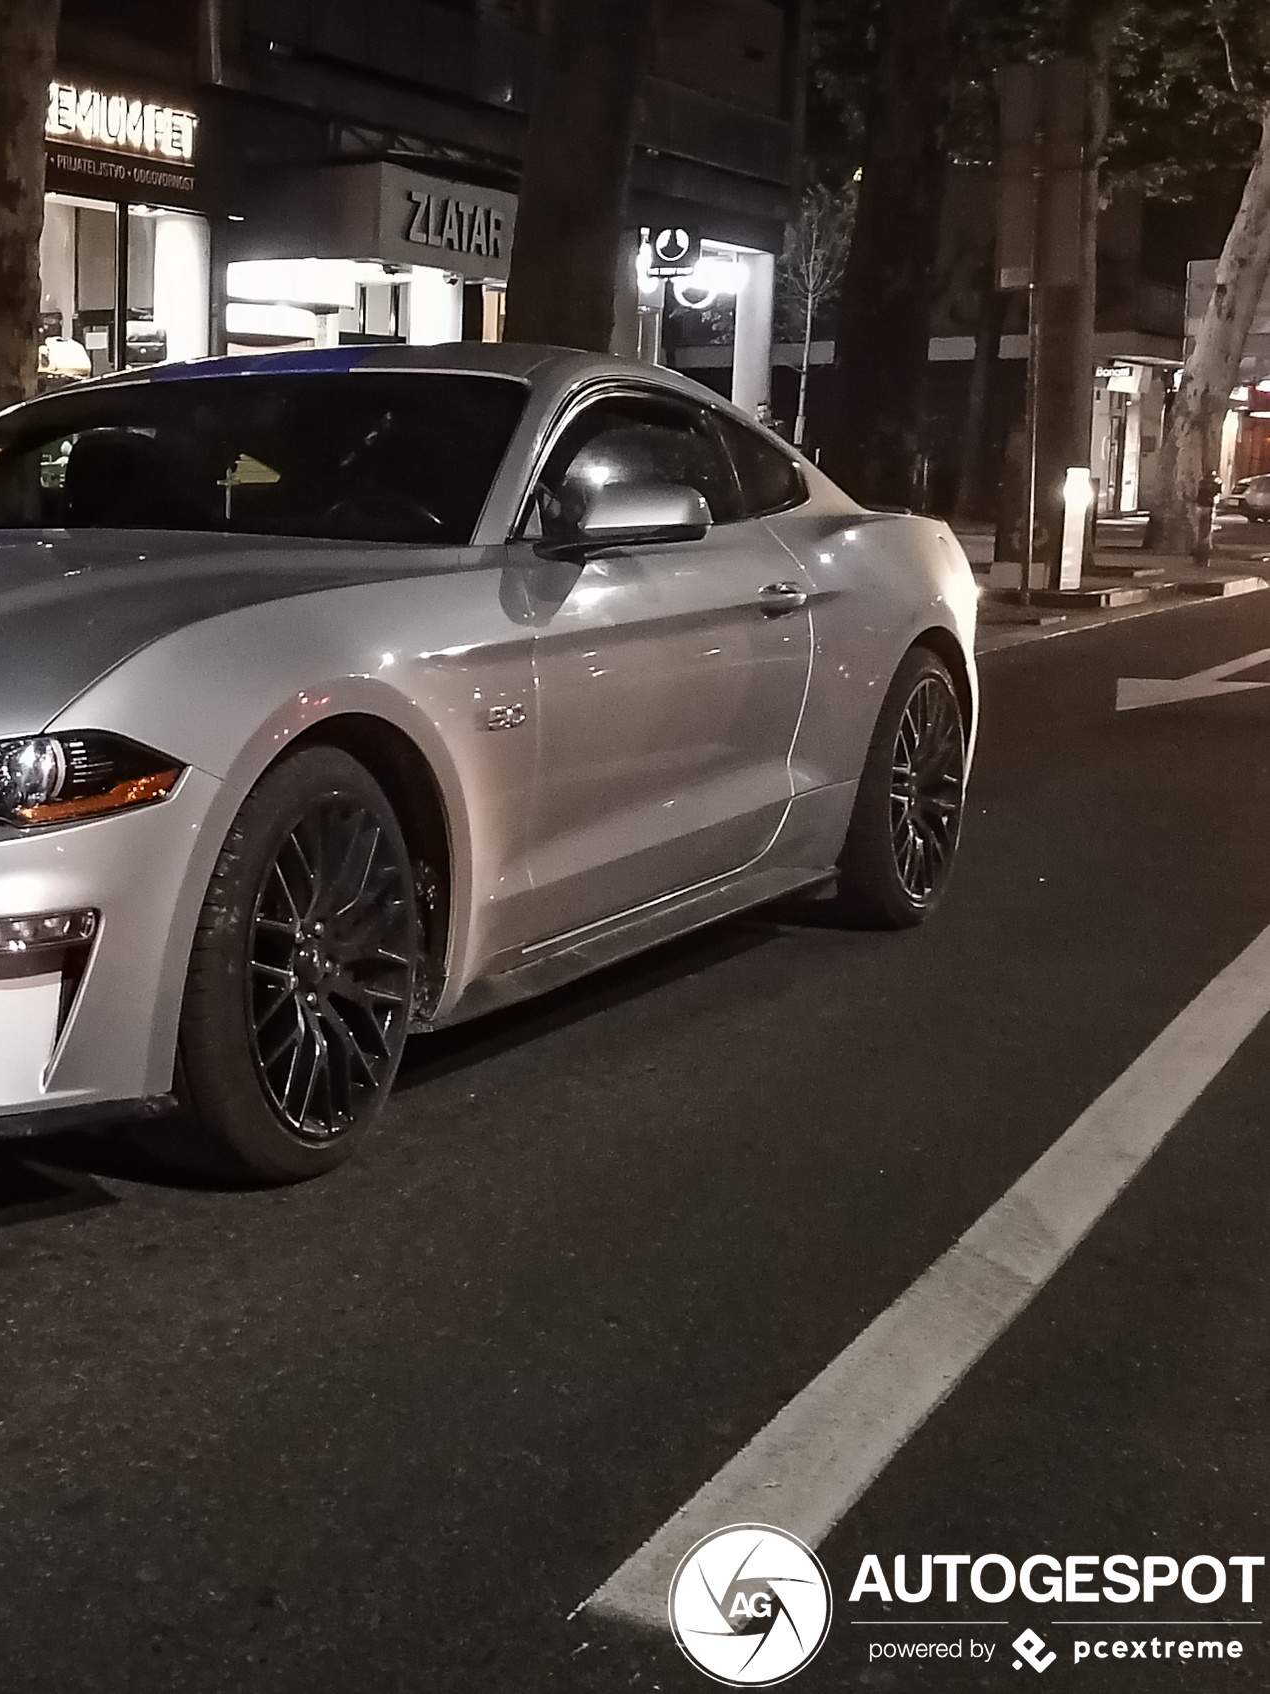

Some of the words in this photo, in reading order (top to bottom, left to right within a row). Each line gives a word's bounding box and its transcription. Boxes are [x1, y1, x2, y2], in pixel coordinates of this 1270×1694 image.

[57, 154, 126, 180] PRIJATELJSTVO
[133, 167, 195, 191] ODGOVORNOST
[408, 190, 506, 258] ZLATAR
